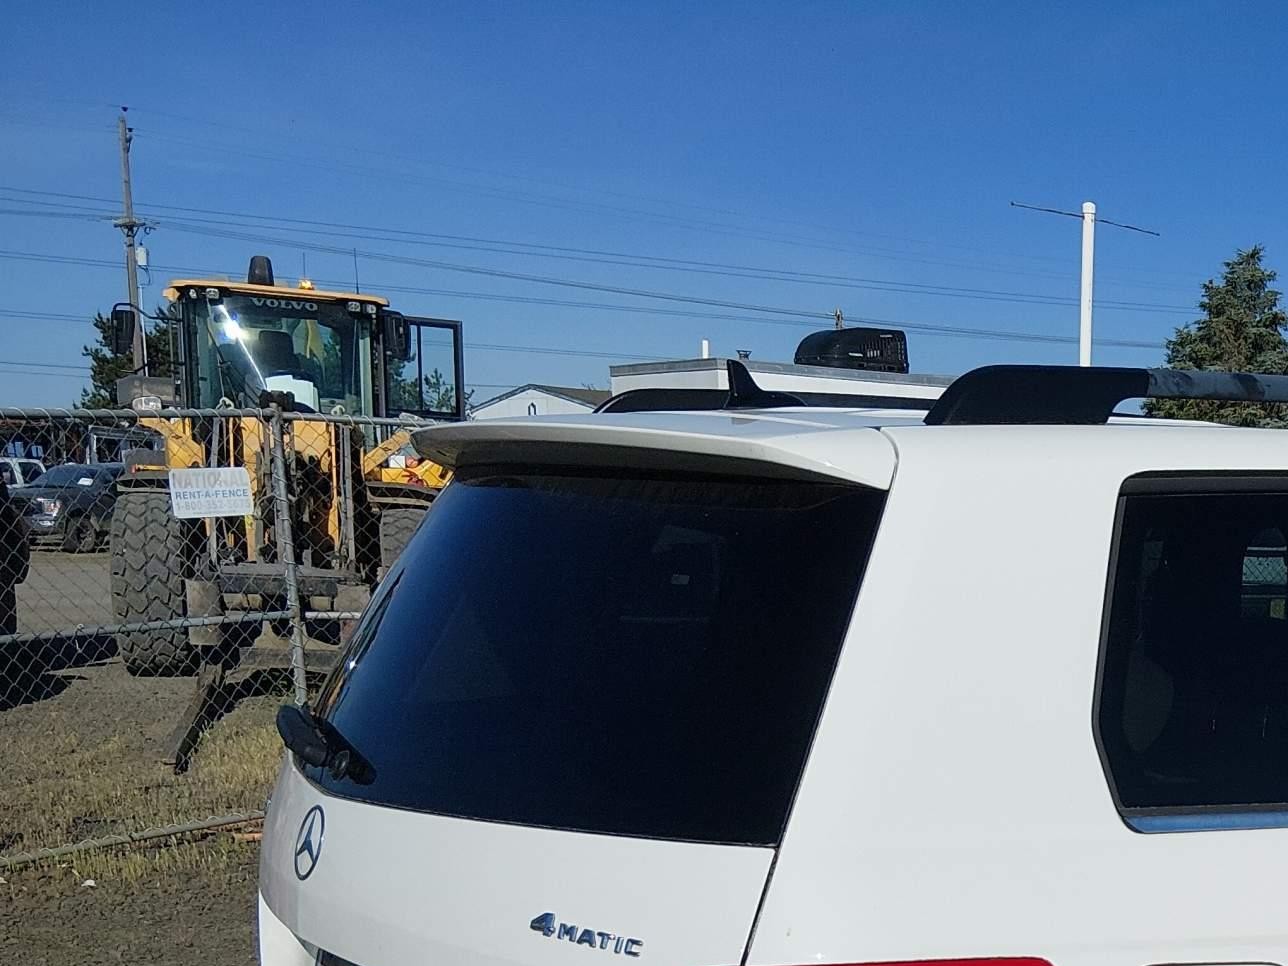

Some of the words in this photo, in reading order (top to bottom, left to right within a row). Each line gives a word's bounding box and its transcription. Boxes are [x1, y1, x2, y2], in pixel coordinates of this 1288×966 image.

[249, 296, 318, 311] VOLVO
[172, 470, 249, 489] NATIONAL
[175, 488, 249, 500] RENT-A-FENCE
[529, 912, 643, 958] 4MATIC
